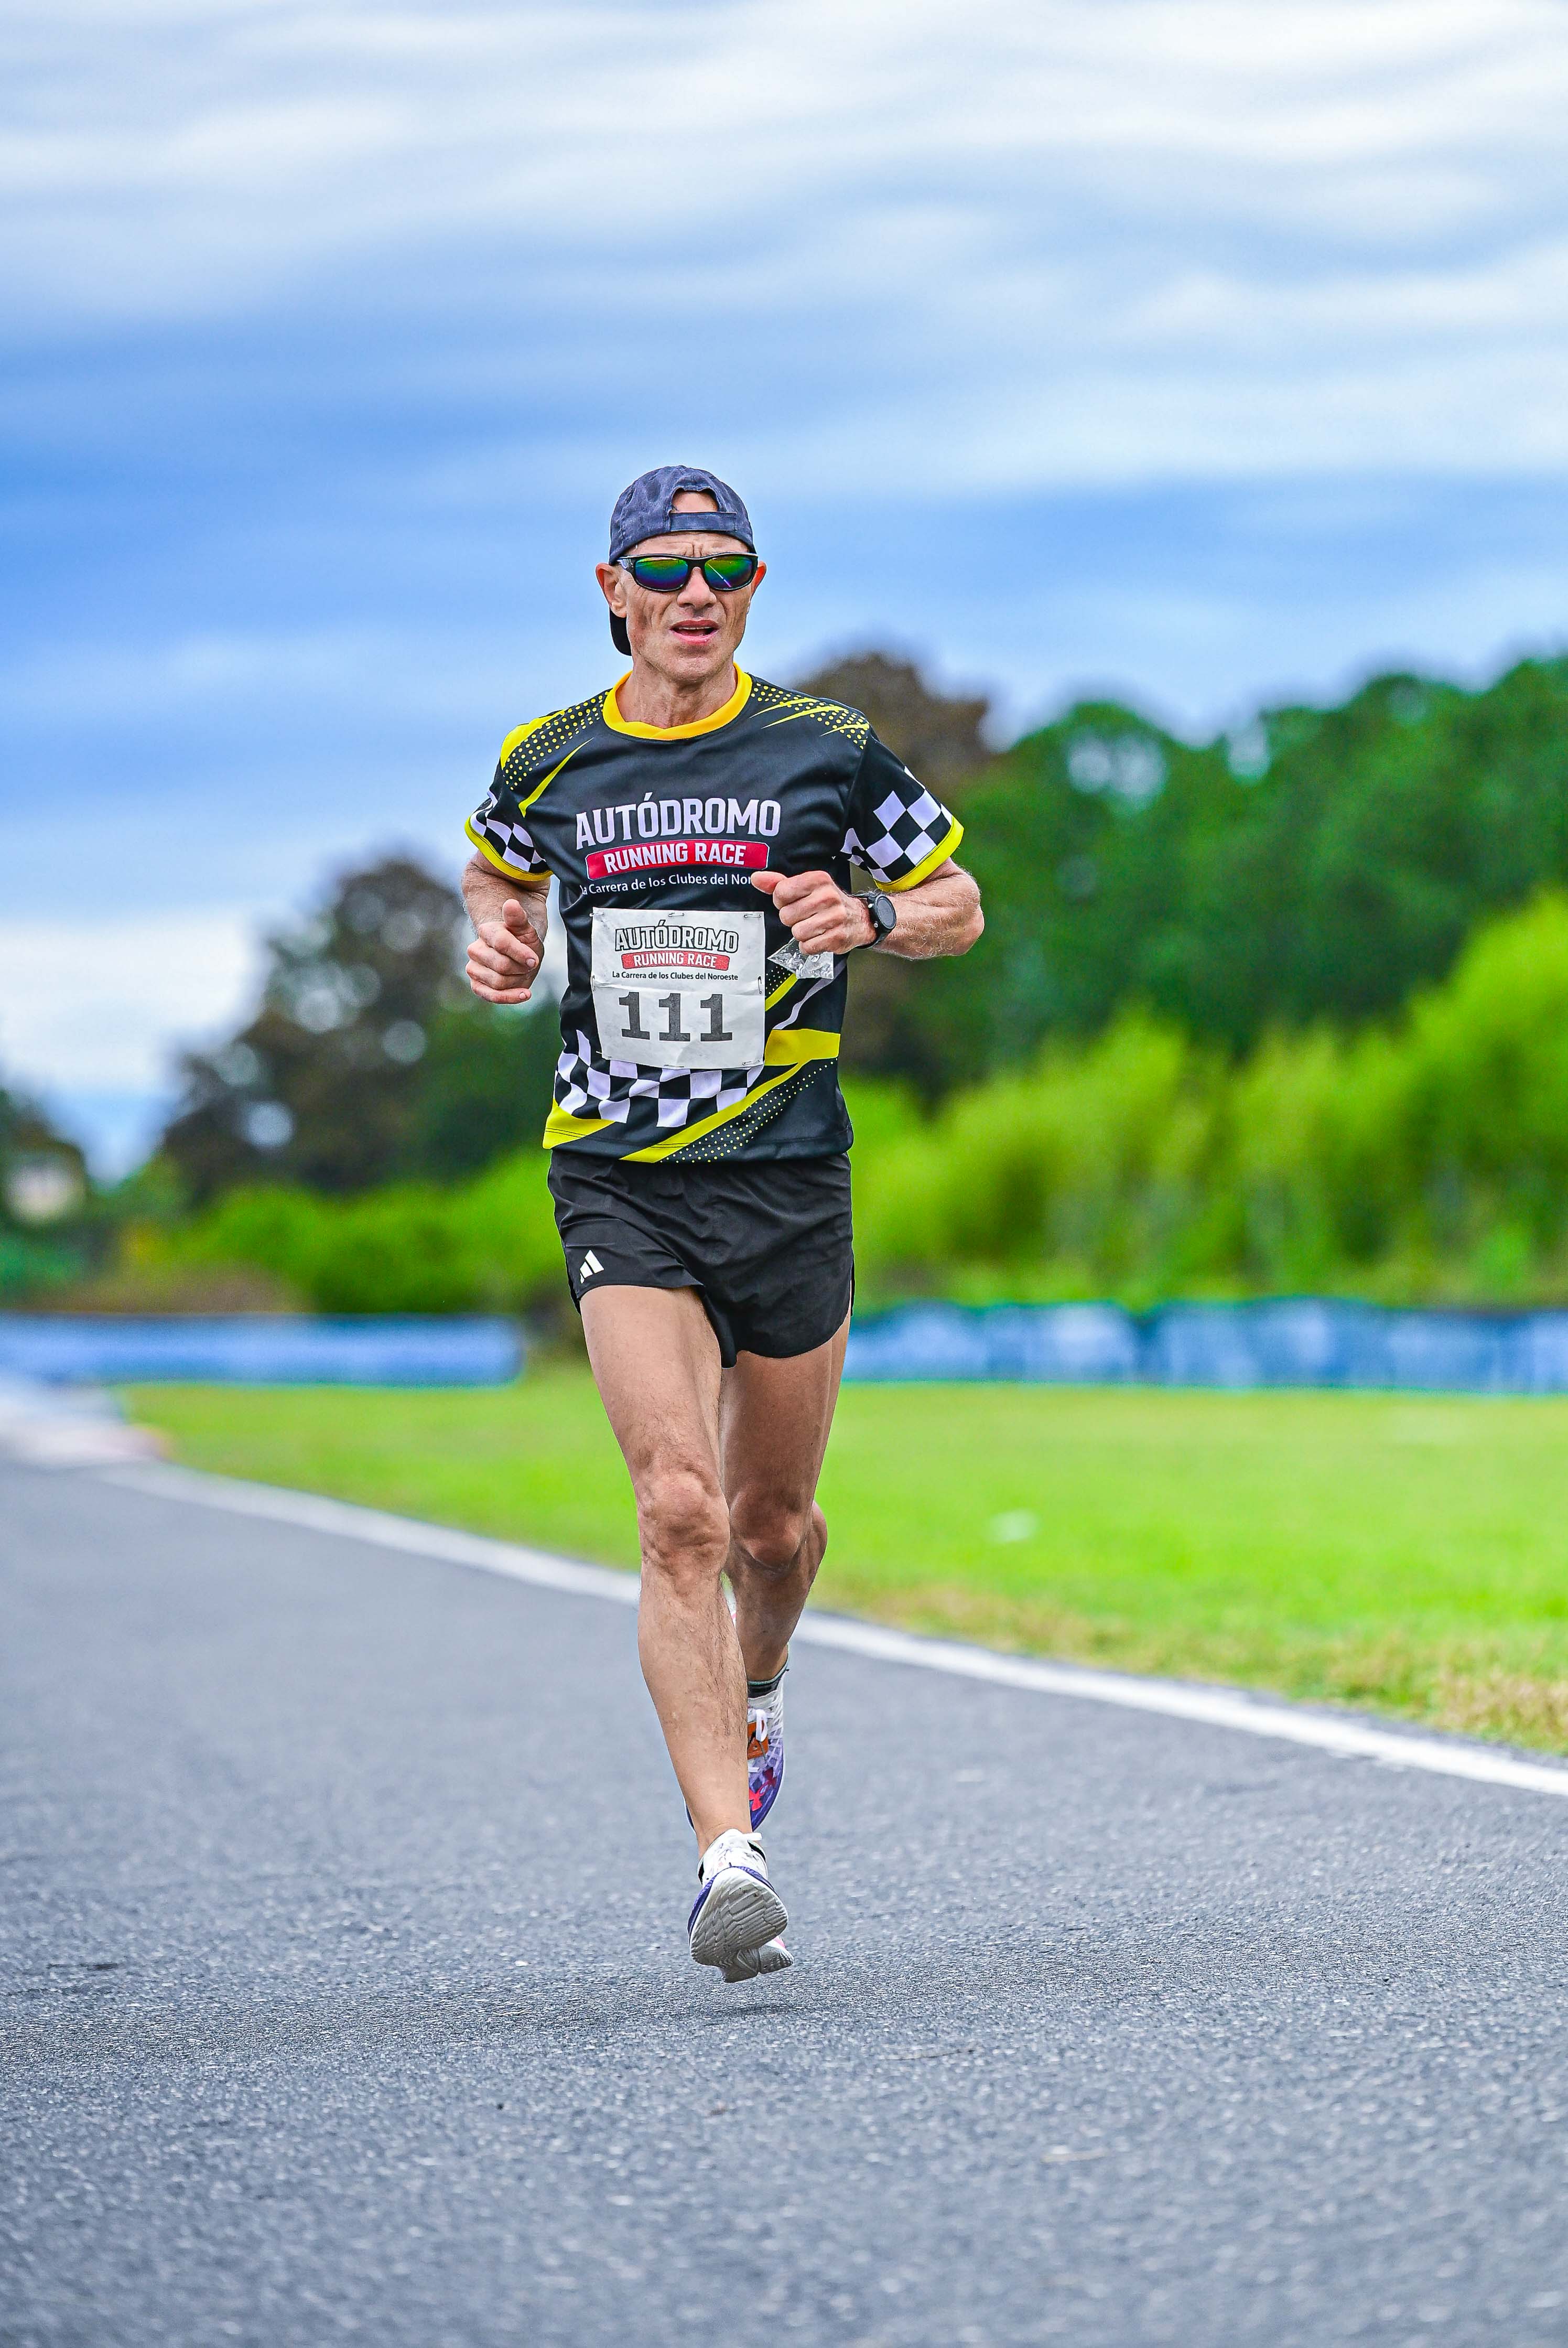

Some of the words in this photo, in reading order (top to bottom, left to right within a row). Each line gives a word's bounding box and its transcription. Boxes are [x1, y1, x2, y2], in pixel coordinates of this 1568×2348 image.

[576, 792, 781, 849] AUTÓDROMO
[603, 843, 688, 874] RUNNING
[695, 844, 747, 865] RACE
[589, 884, 628, 894] Carrera
[631, 879, 646, 890] de
[648, 878, 666, 887] los
[668, 874, 707, 884] Clubes
[710, 874, 727, 885] del
[615, 920, 739, 953] AUTÓDROMO
[634, 952, 684, 966] RUNNING
[688, 954, 717, 967] RACE
[619, 992, 732, 1042] 111
